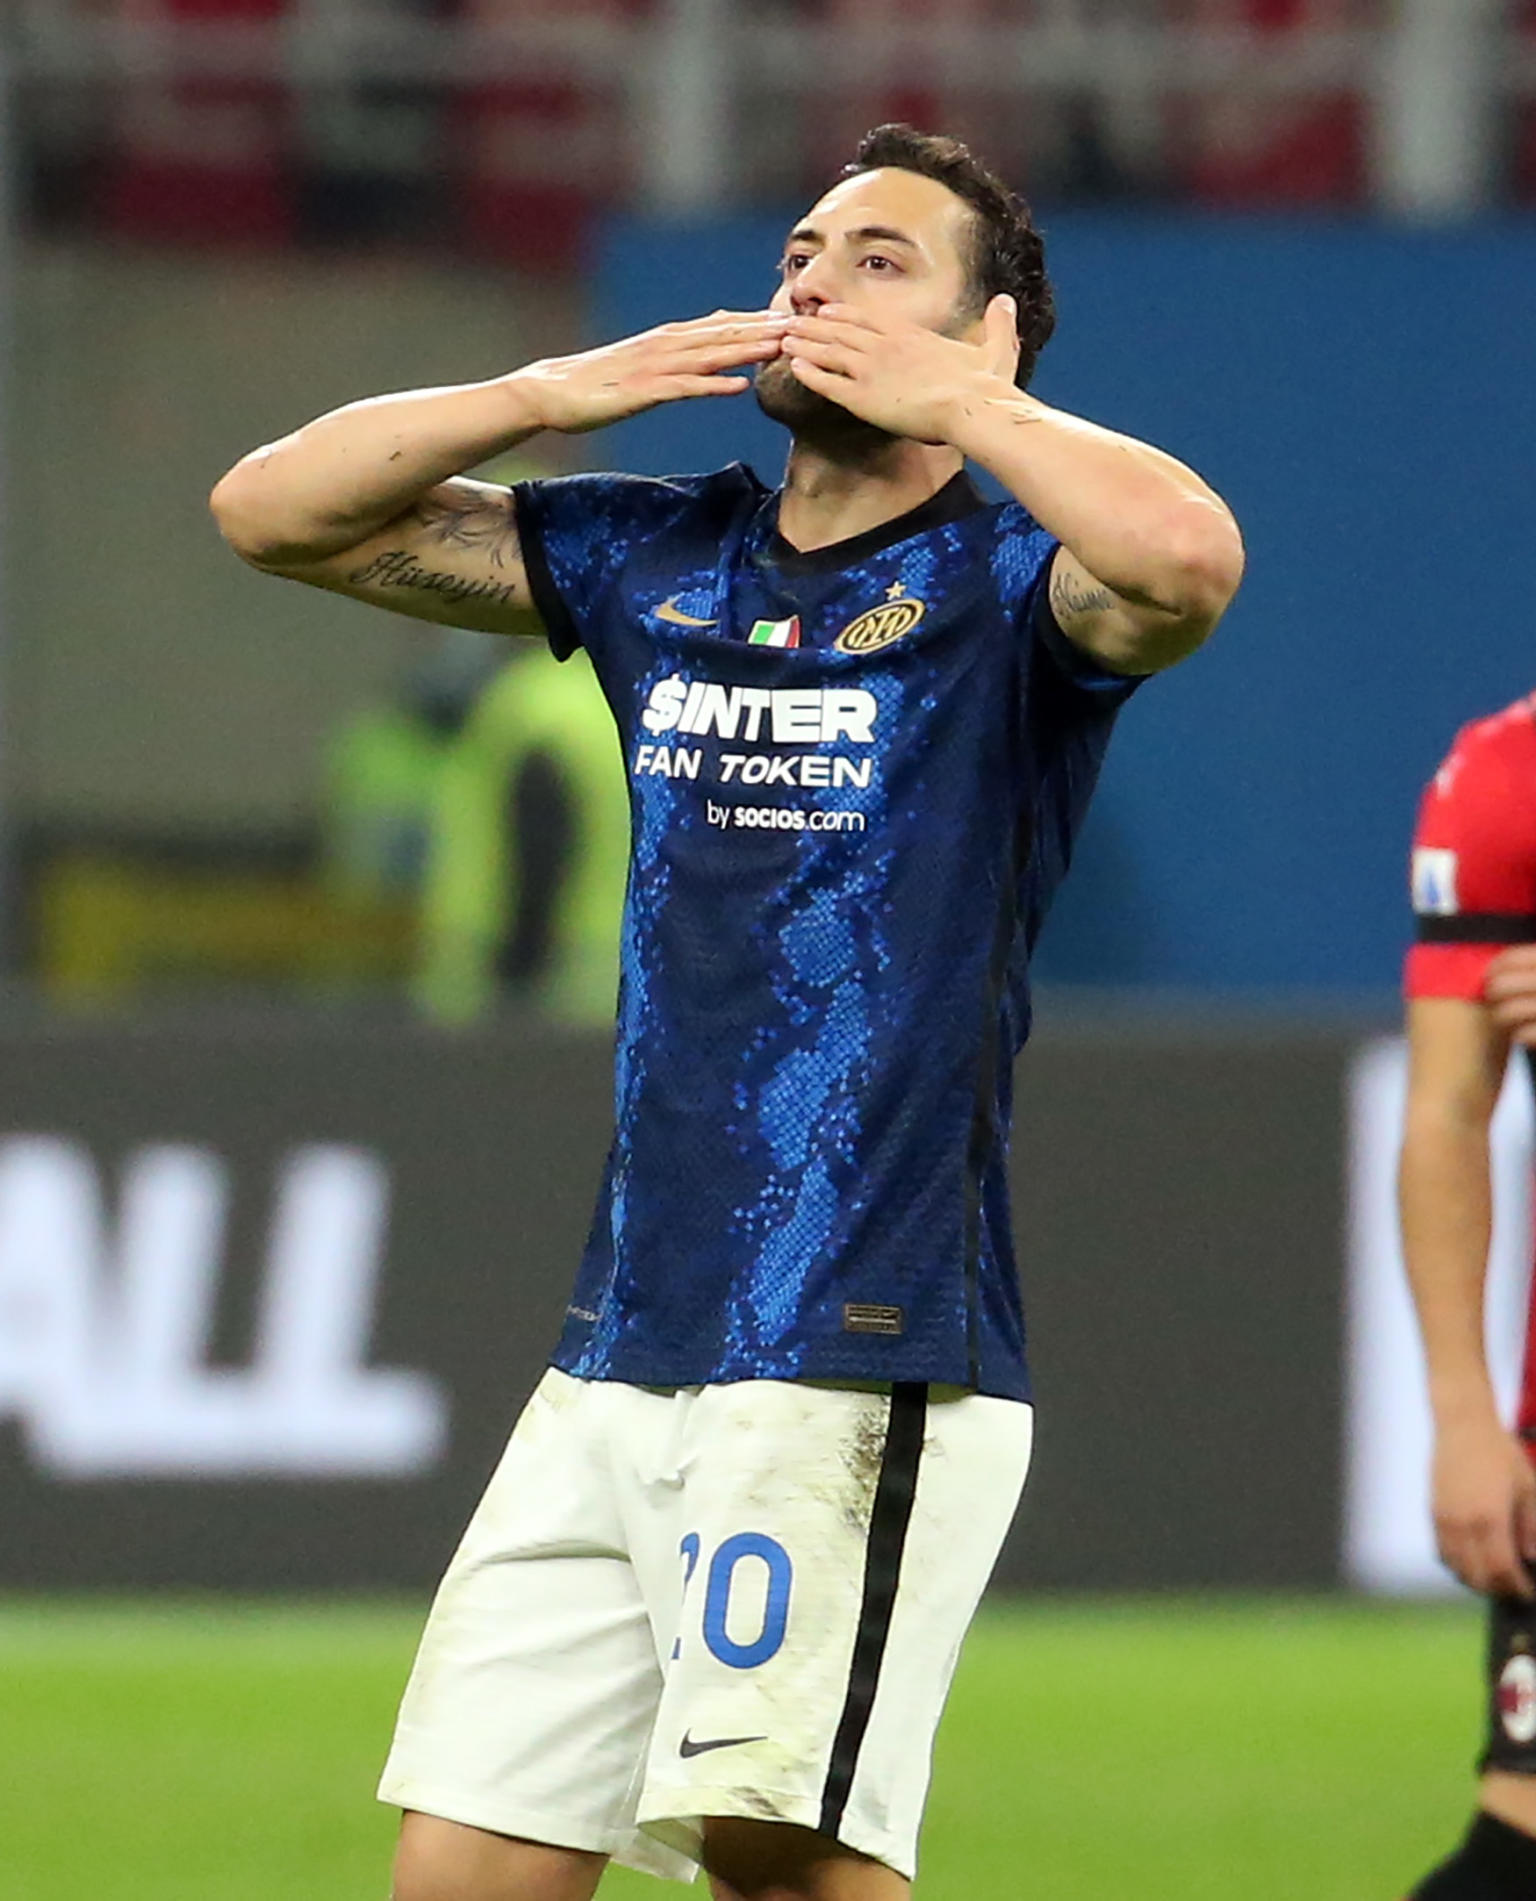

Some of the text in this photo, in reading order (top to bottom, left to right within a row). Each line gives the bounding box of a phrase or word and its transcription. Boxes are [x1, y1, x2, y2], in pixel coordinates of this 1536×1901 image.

[642, 673, 877, 743] $INTER
[635, 745, 872, 788] FAN TOKEN
[706, 800, 865, 832] by socios.com
